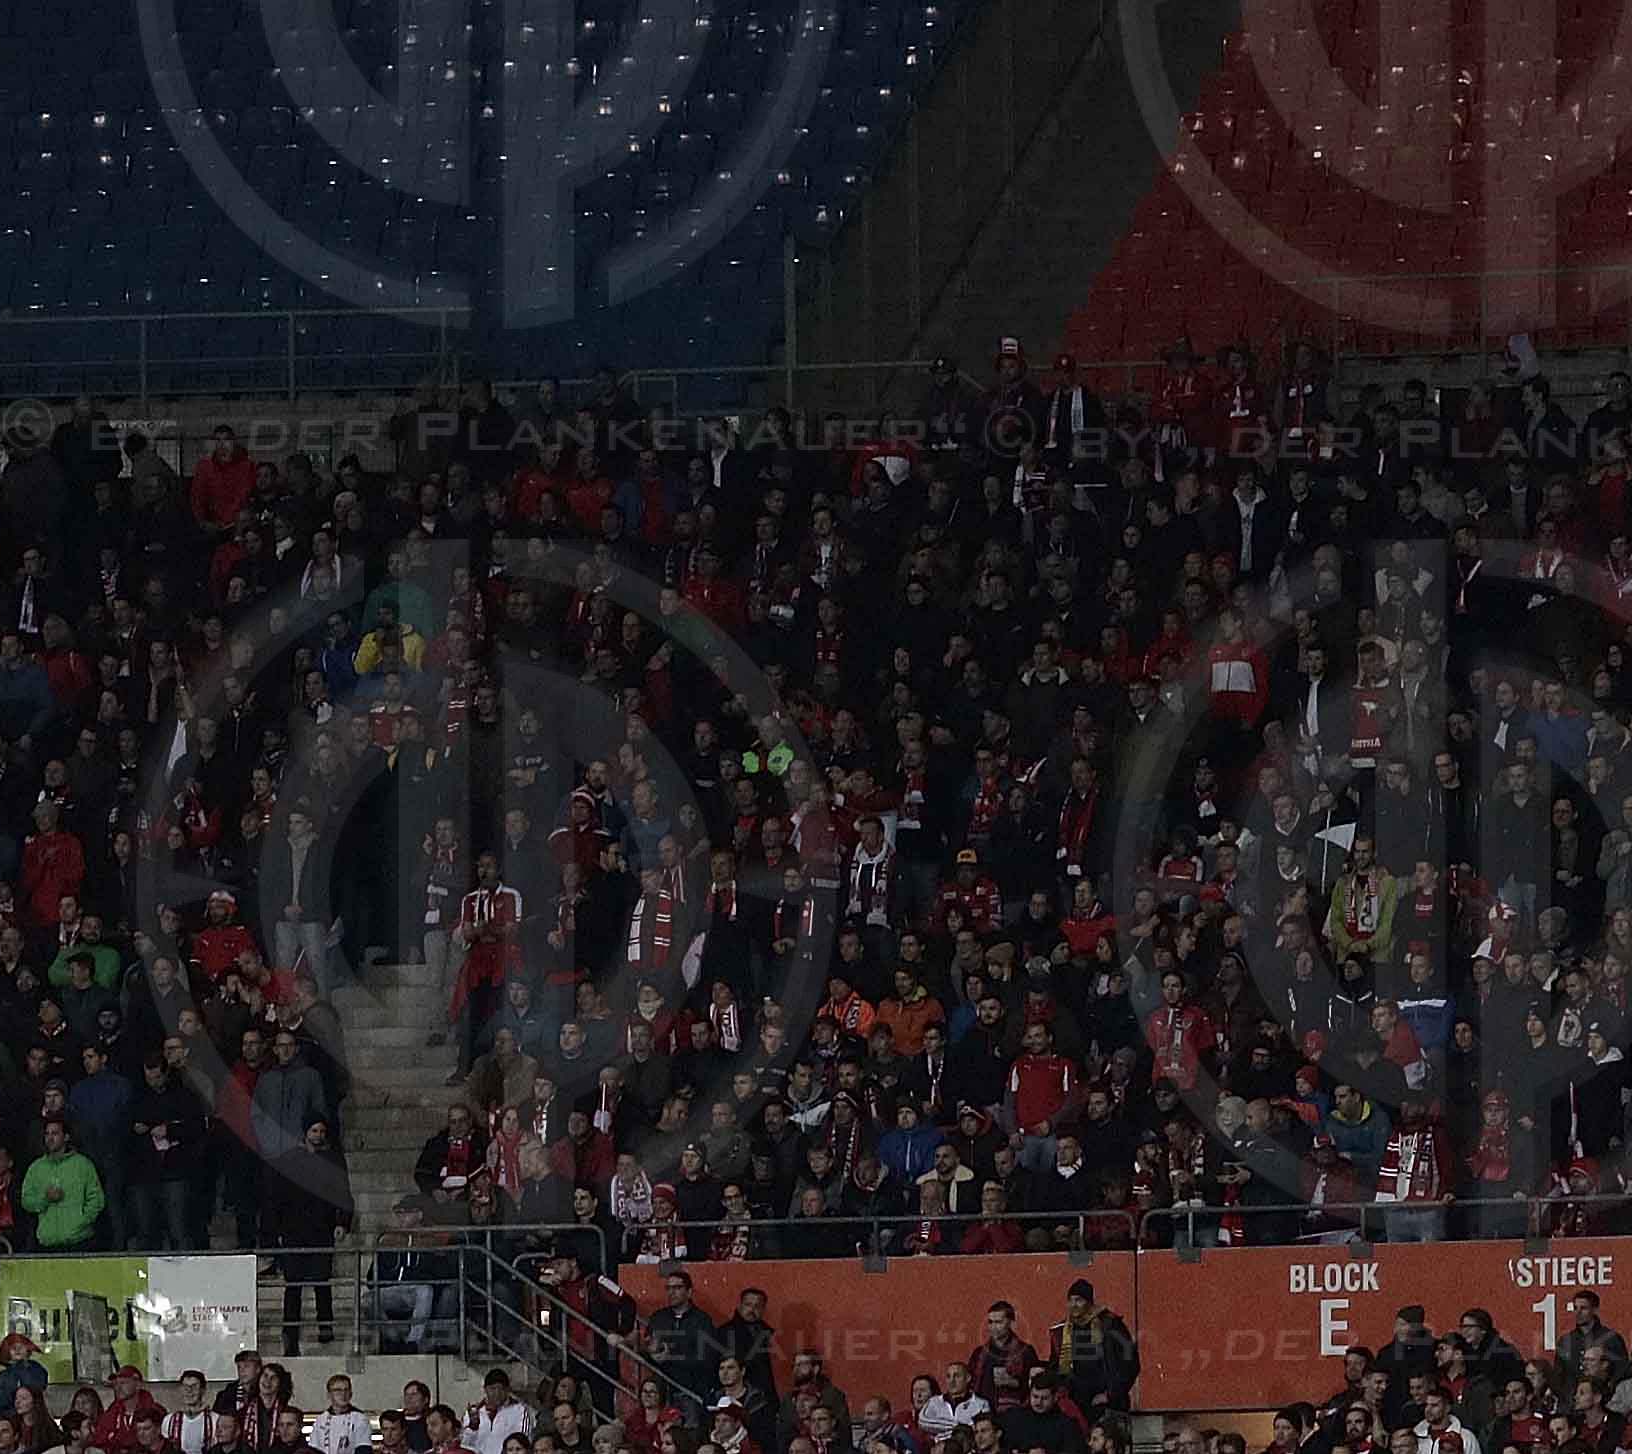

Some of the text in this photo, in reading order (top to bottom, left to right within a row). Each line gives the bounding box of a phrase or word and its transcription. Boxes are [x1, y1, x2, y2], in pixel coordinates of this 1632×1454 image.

[1290, 1262, 1381, 1293] BLOCK
[1516, 1256, 1614, 1288] STIEGE
[1320, 1299, 1351, 1356] E
